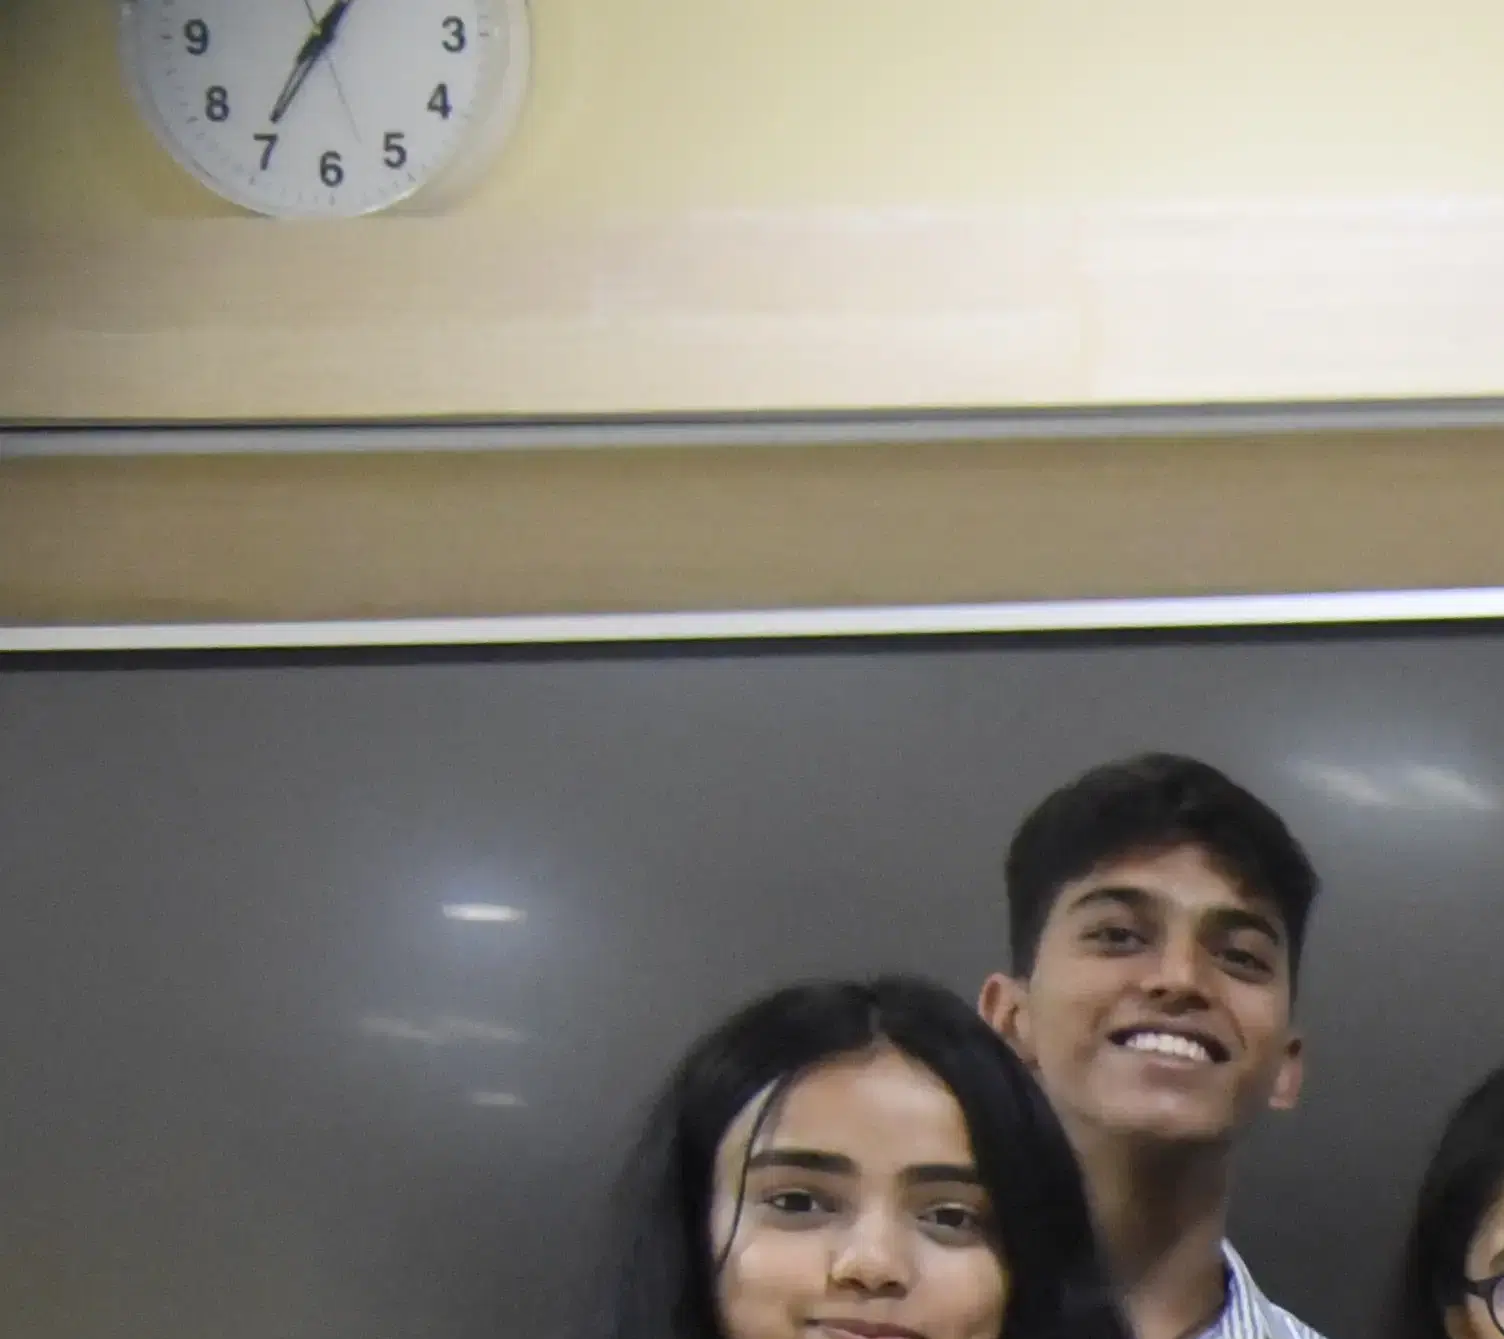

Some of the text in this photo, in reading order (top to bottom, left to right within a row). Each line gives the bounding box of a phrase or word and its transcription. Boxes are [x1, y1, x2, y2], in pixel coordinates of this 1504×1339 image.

[183, 18, 209, 55] 9
[441, 16, 466, 52] 3
[205, 86, 230, 122] 8
[427, 83, 452, 119] 4
[253, 134, 279, 170] 7
[383, 133, 407, 168] 5
[319, 151, 344, 187] 6
